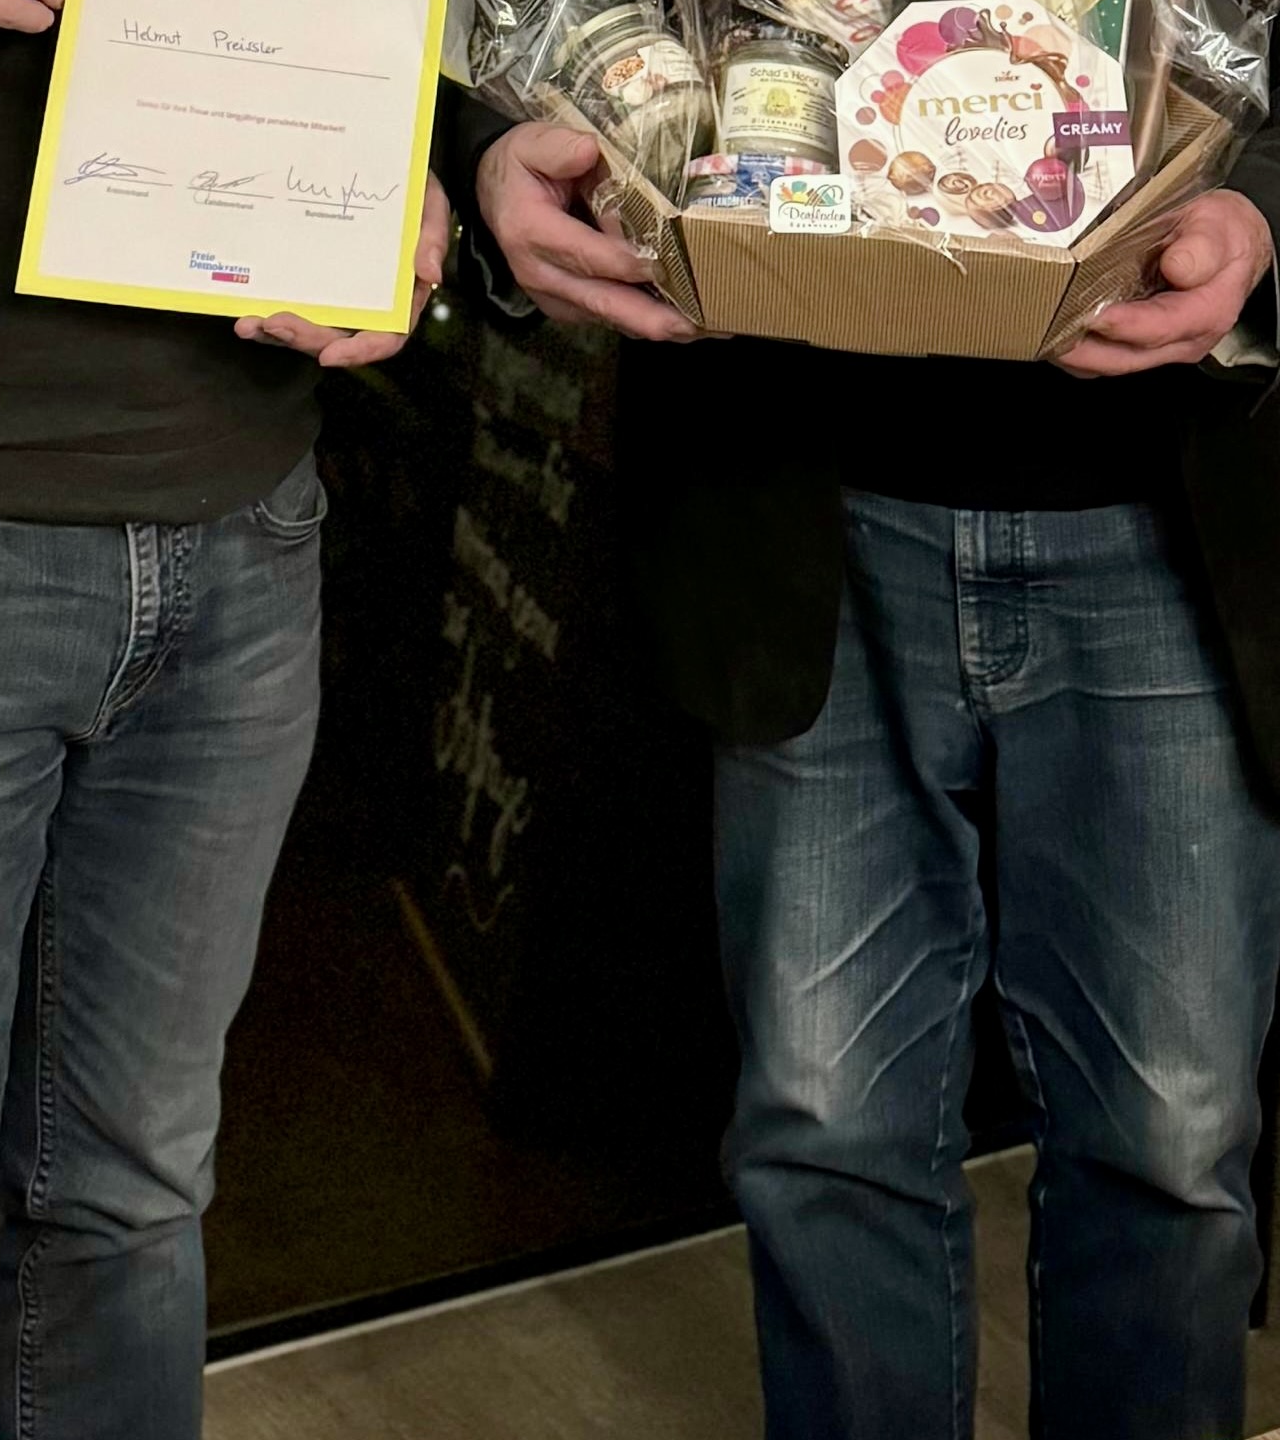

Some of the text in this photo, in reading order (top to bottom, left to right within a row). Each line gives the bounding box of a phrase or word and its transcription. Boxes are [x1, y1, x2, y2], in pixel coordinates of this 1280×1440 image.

[123, 18, 283, 55] Helmut Preissler
[918, 82, 1044, 117] merci
[944, 115, 1029, 147] lovelies
[1059, 122, 1123, 136] CREAMY
[189, 259, 251, 274] Demokraten
[190, 250, 216, 262] Freie
